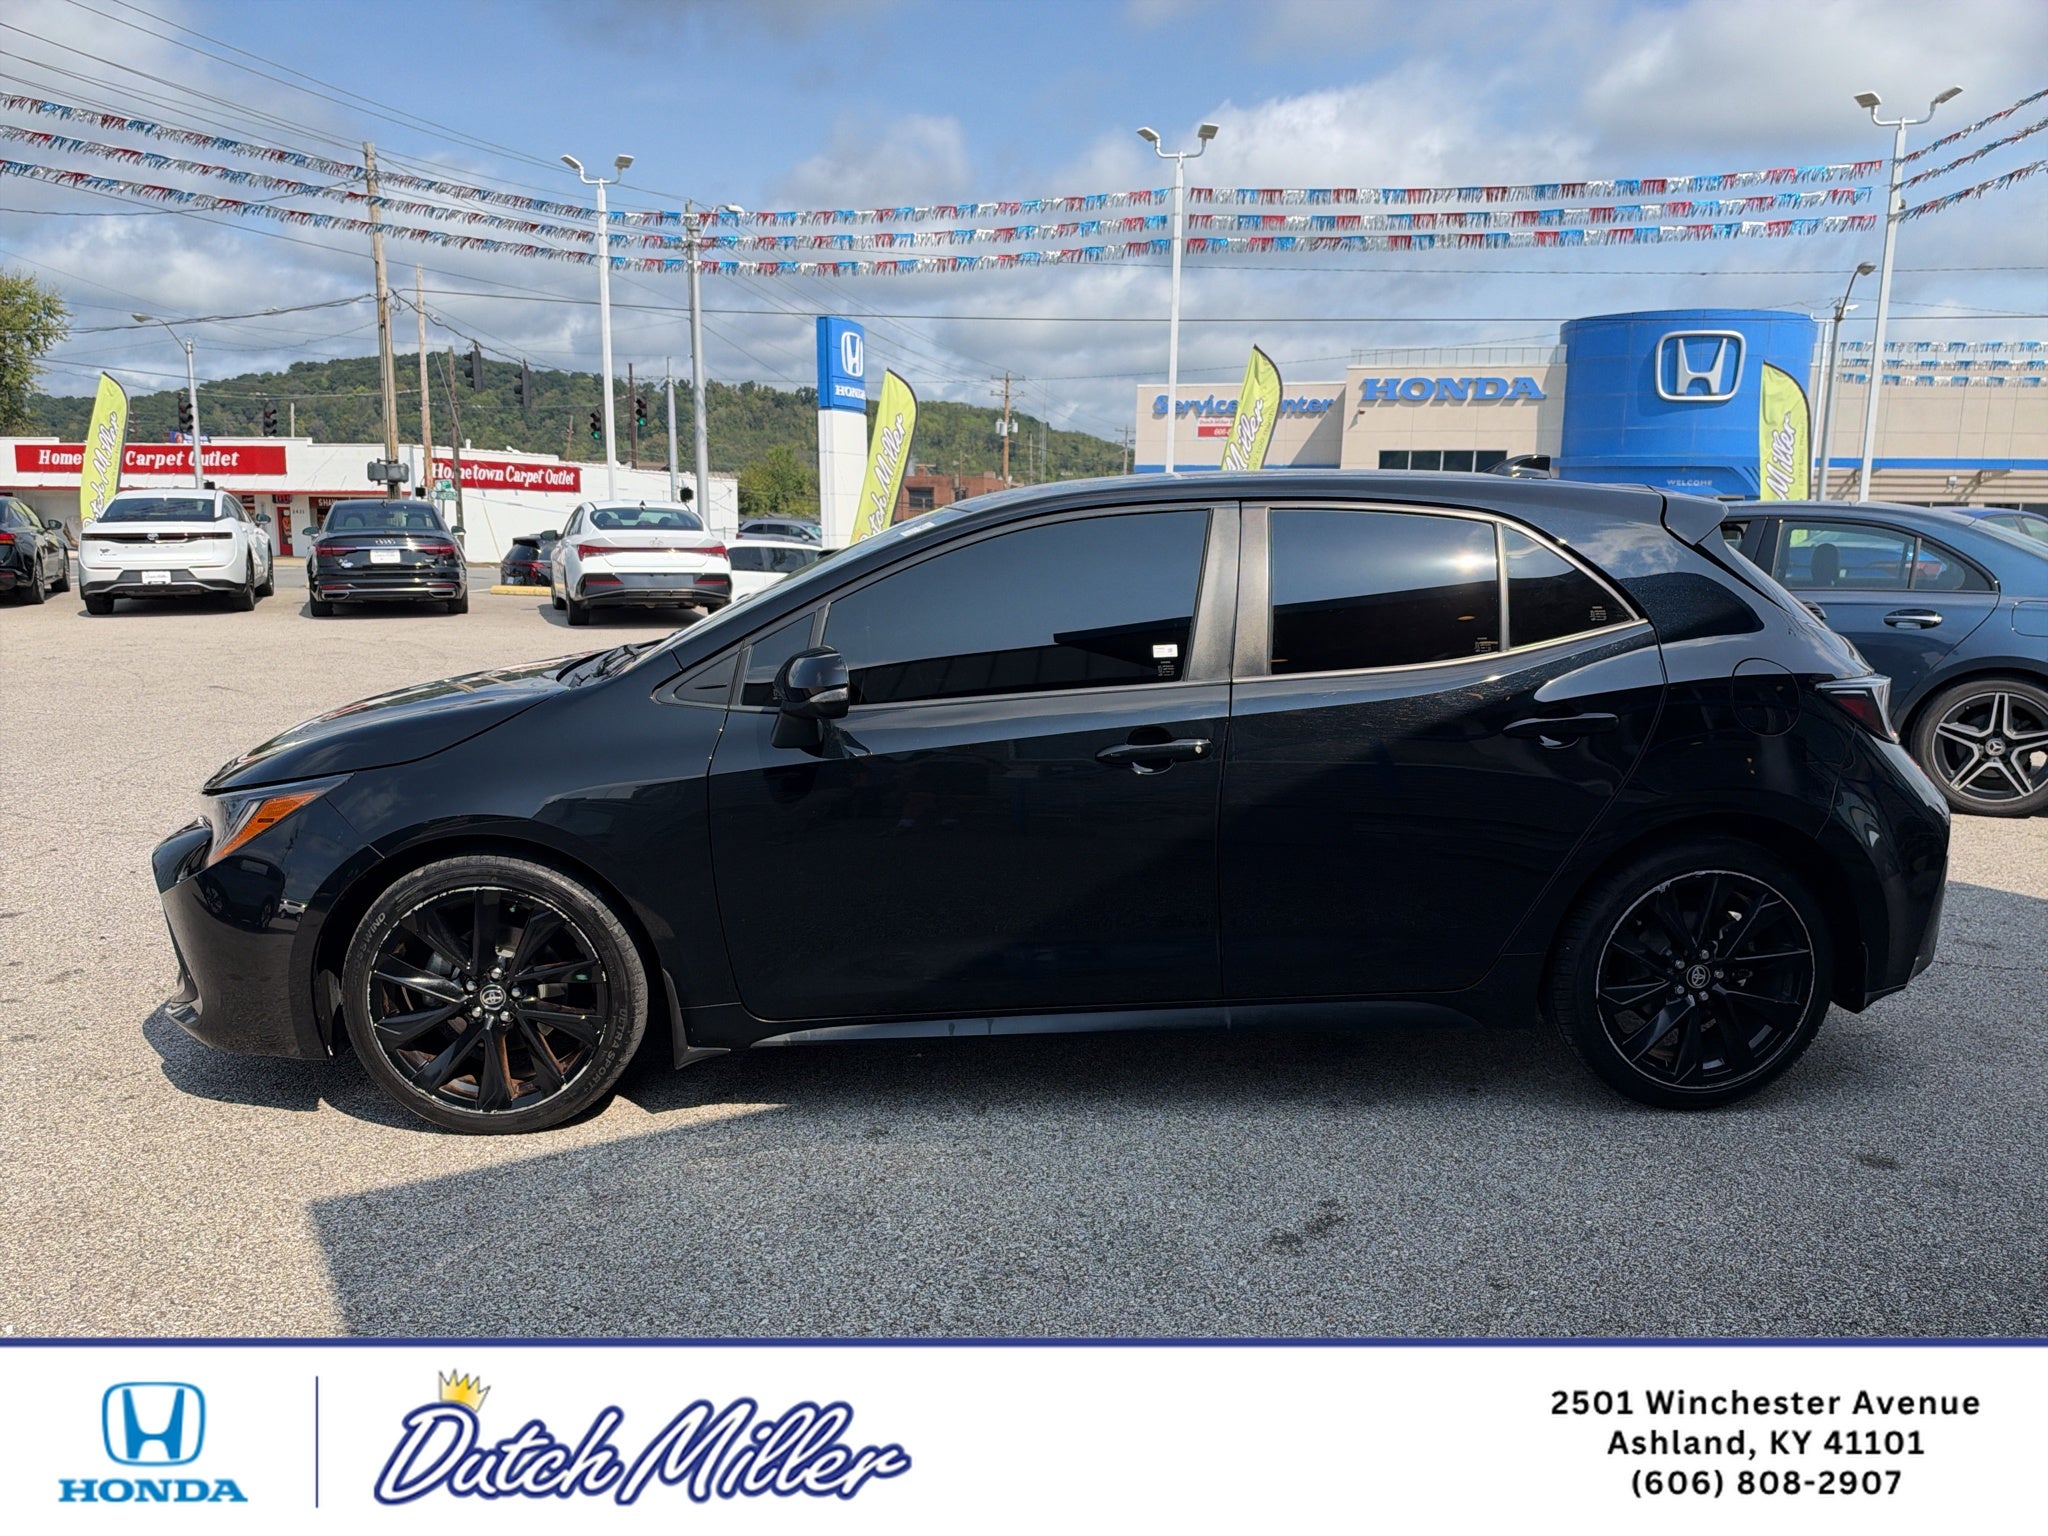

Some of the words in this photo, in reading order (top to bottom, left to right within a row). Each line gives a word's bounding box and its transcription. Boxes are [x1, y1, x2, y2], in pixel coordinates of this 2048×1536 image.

[1362, 377, 1546, 400] HONDA
[1154, 394, 1240, 414] Service
[1281, 395, 1334, 413] nter
[93, 411, 118, 485] Miller
[874, 413, 906, 498] Miller
[1766, 411, 1797, 500] Miller
[125, 450, 185, 469] Carpet
[505, 465, 543, 487] Carpet
[545, 469, 575, 486] Outlet
[1666, 479, 1713, 487] WELCOME
